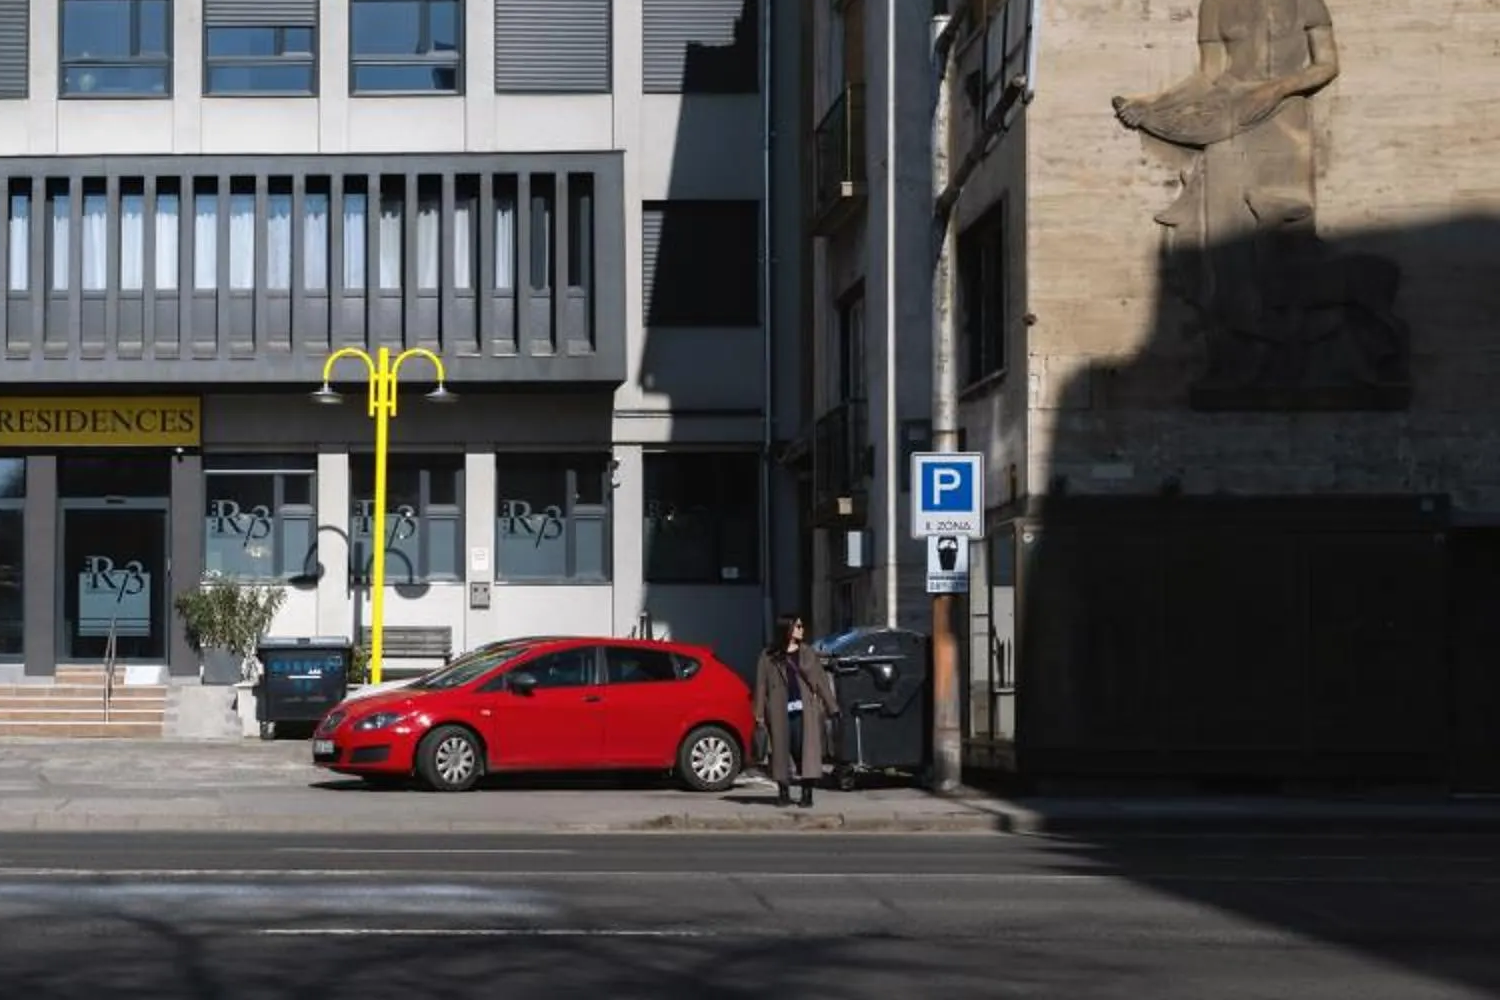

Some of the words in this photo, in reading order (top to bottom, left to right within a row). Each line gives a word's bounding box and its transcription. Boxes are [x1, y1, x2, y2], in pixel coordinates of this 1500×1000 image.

[933, 468, 961, 506] P
[212, 500, 270, 547] R73
[506, 500, 563, 549] R73
[88, 556, 144, 604] R73
